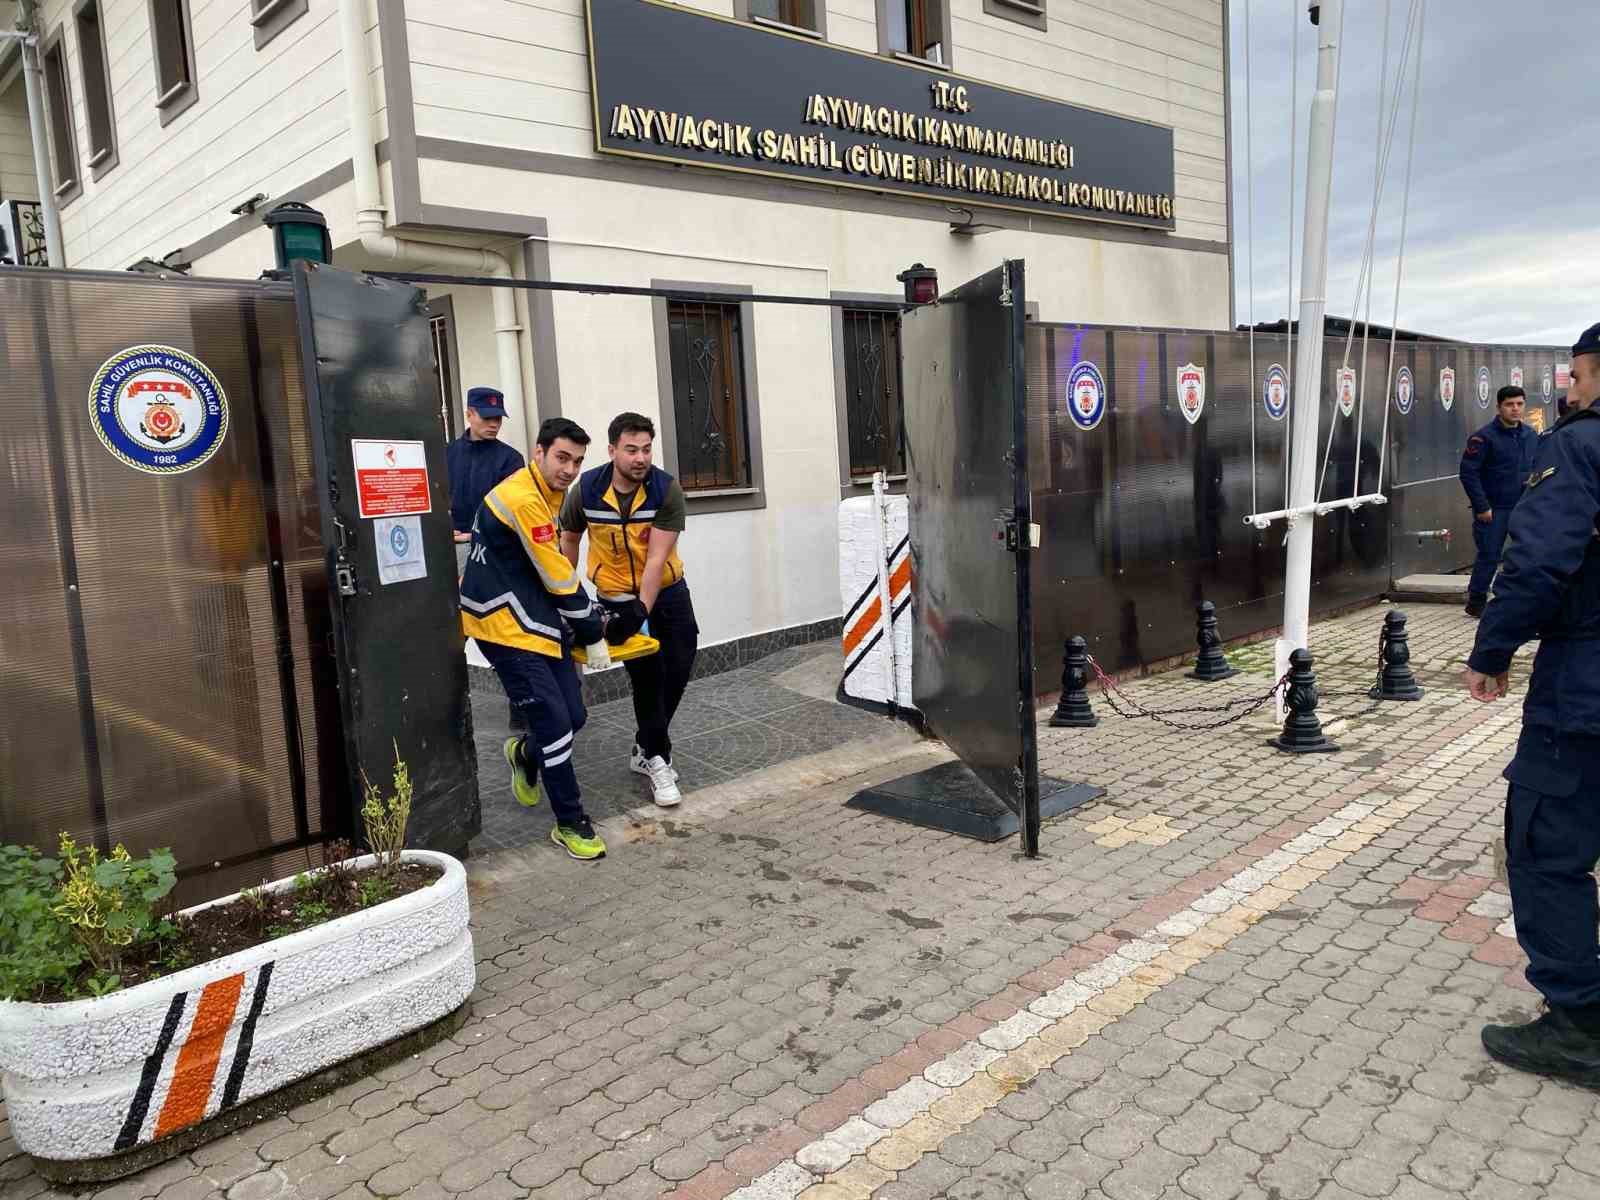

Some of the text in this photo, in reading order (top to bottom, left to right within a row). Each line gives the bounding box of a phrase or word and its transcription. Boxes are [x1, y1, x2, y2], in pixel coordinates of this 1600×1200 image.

[809, 93, 917, 138] AYVACIK
[612, 103, 752, 156] AYVACIK
[759, 130, 842, 168] SAHİL
[848, 142, 967, 188] GÜVENLİK
[971, 165, 1062, 202] KARAKOL
[100, 354, 219, 415] SAHİL GÜVENLİK KOMUTANLIĞI
[153, 455, 177, 464] 1982
